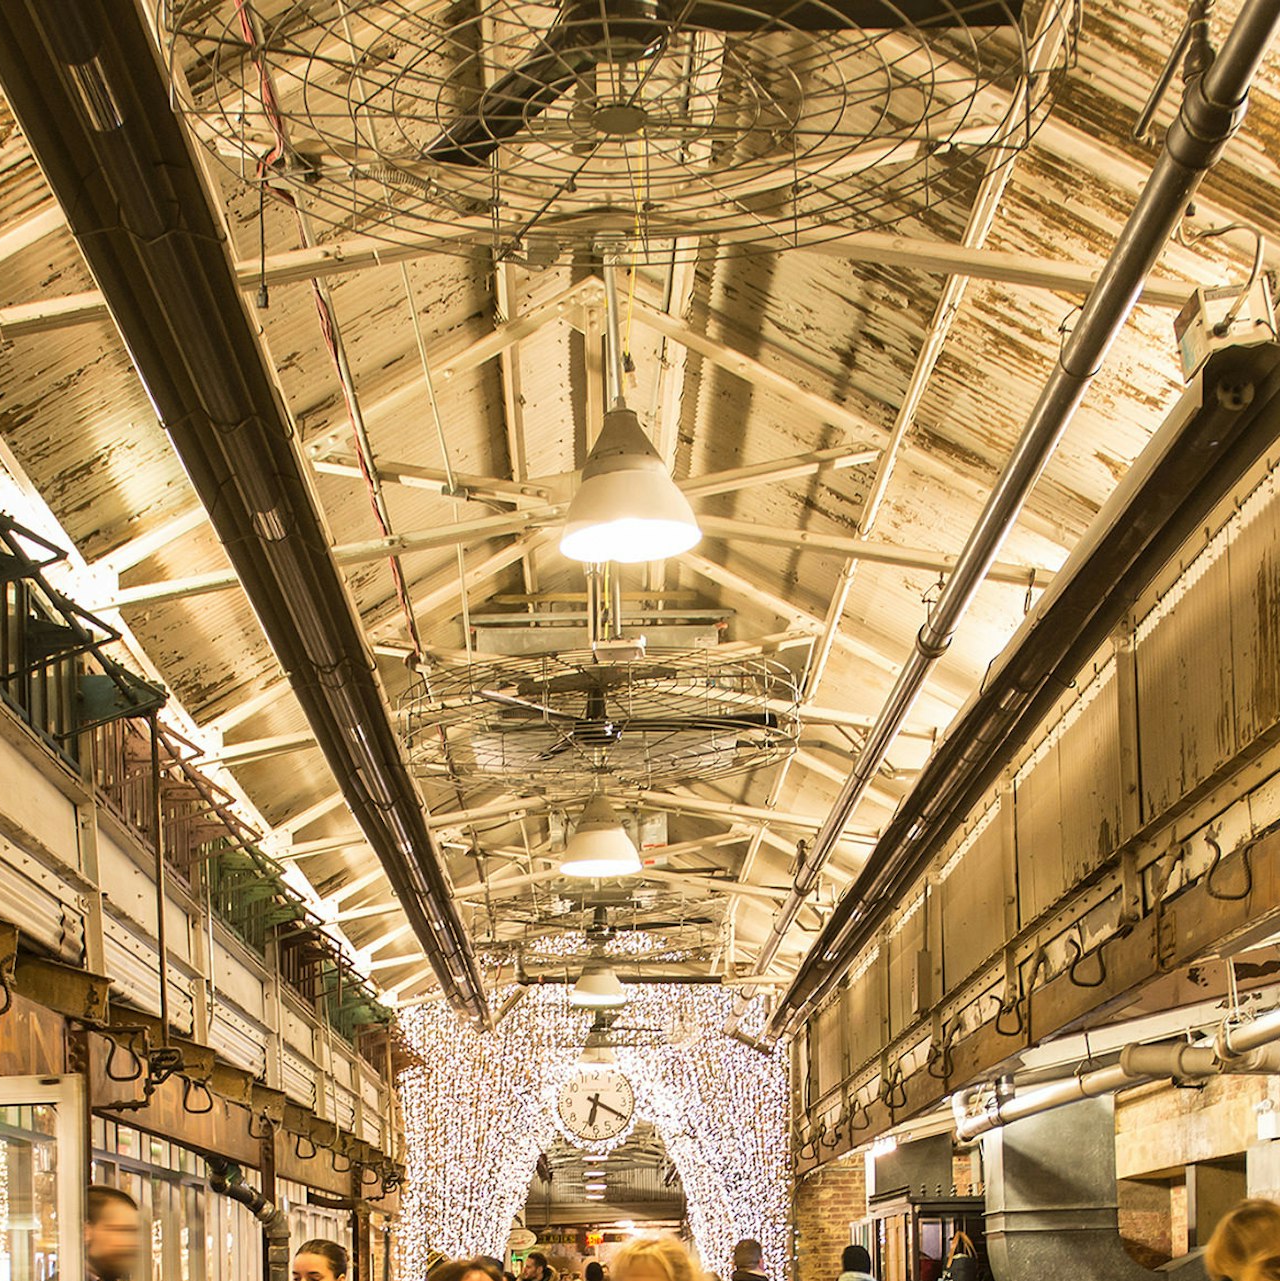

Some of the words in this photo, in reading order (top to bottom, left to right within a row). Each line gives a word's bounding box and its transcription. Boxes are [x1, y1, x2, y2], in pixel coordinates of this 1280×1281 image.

[591, 1071, 600, 1081] 12
[569, 1082, 579, 1093] 10
[615, 1082, 623, 1093] 2
[565, 1097, 573, 1108] 9
[620, 1097, 627, 1107] 3
[569, 1112, 577, 1122] 8
[582, 1120, 589, 1131] 7
[592, 1124, 600, 1135] 6
[604, 1120, 612, 1131] 5
